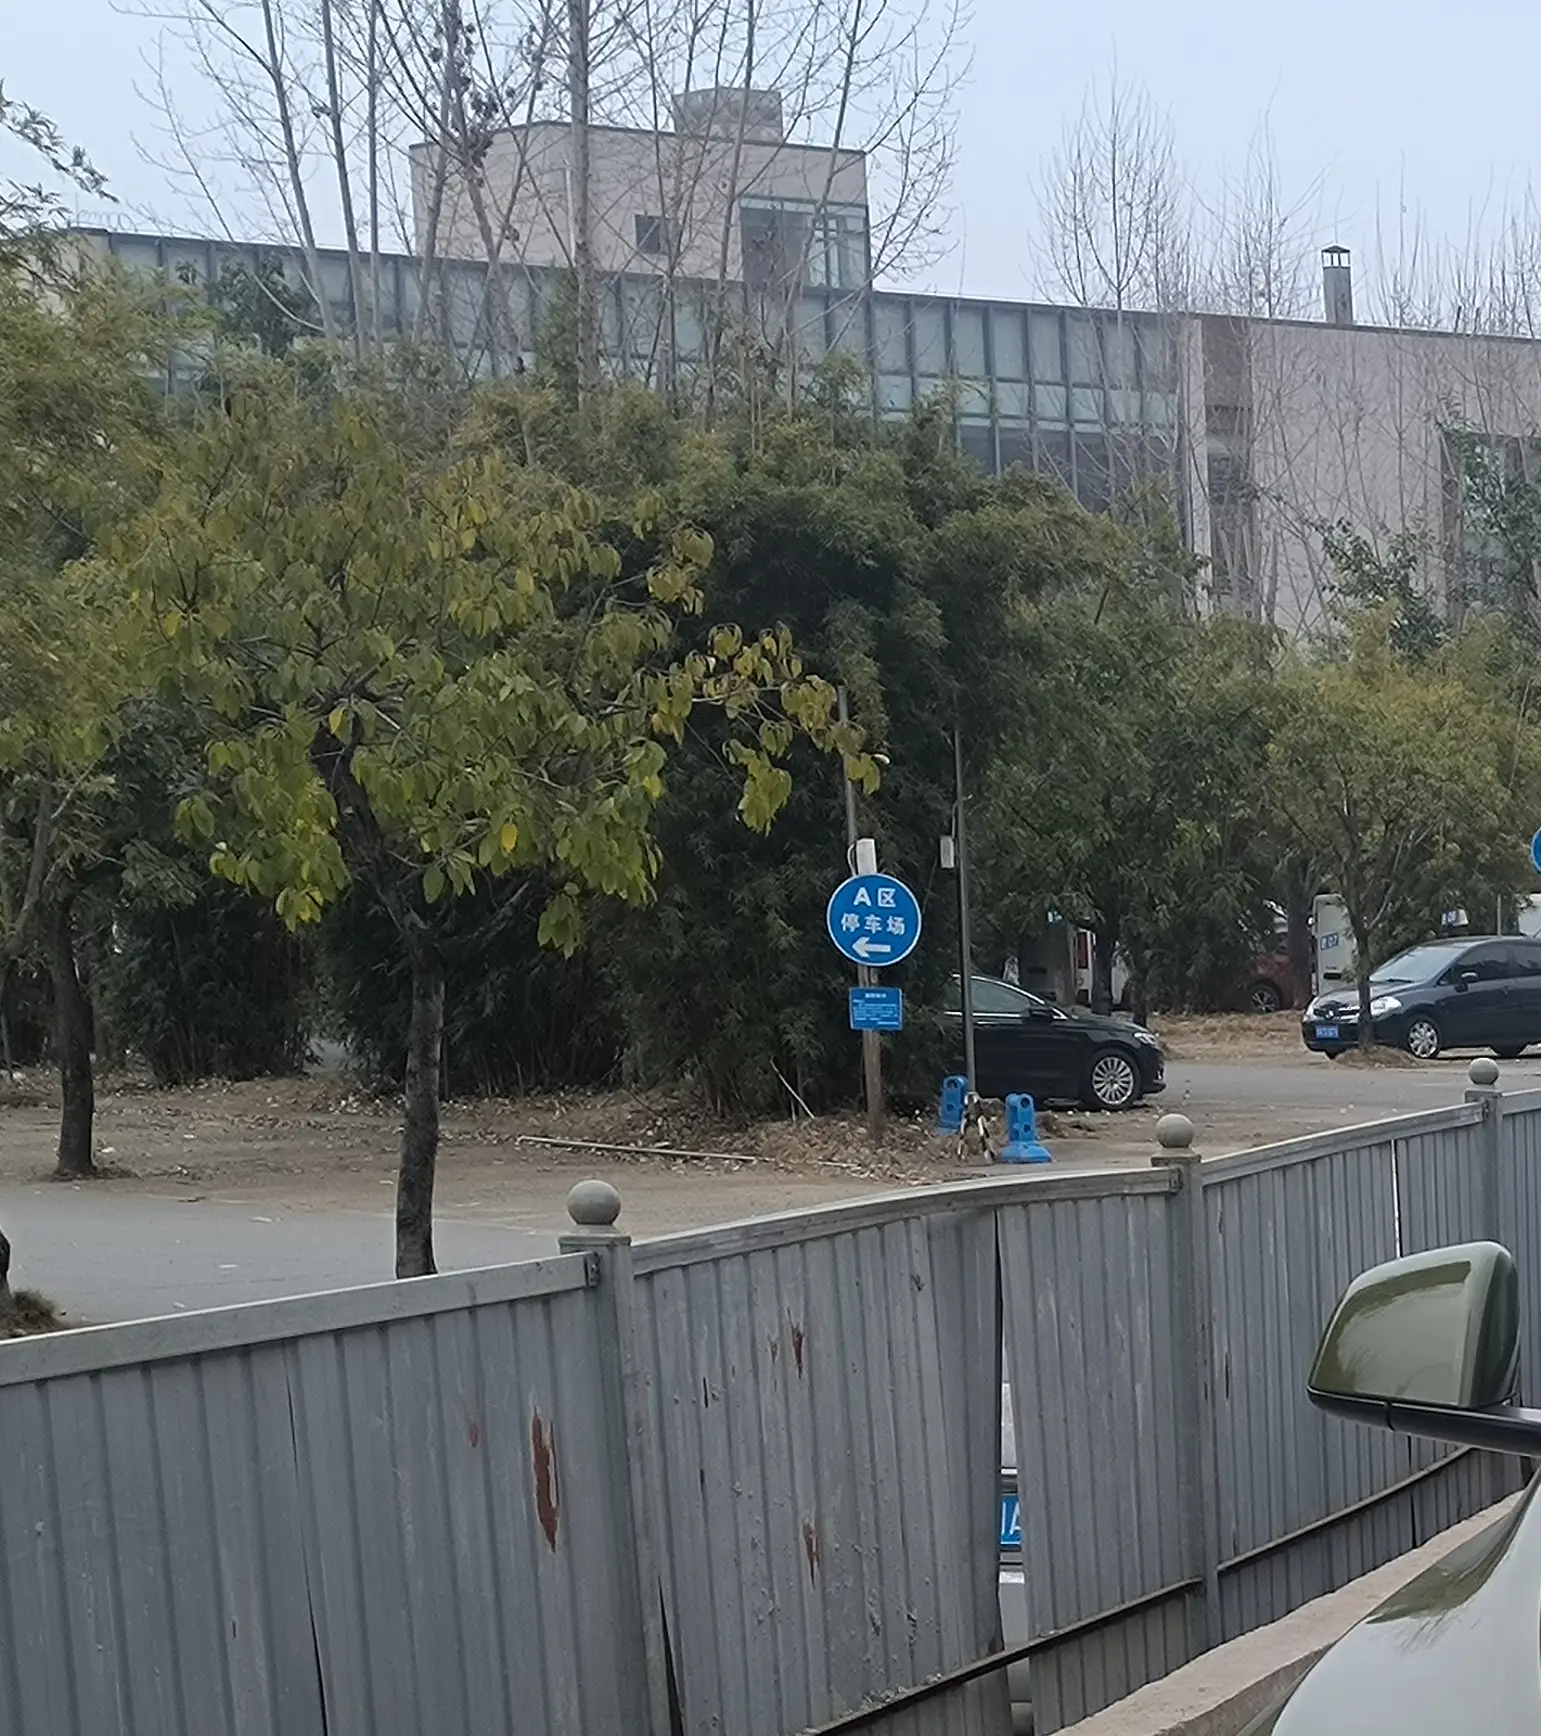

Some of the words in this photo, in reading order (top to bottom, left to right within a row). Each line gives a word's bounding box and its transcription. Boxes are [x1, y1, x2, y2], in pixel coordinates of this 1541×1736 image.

[853, 886, 897, 908] A区
[840, 913, 906, 936] 停车场
